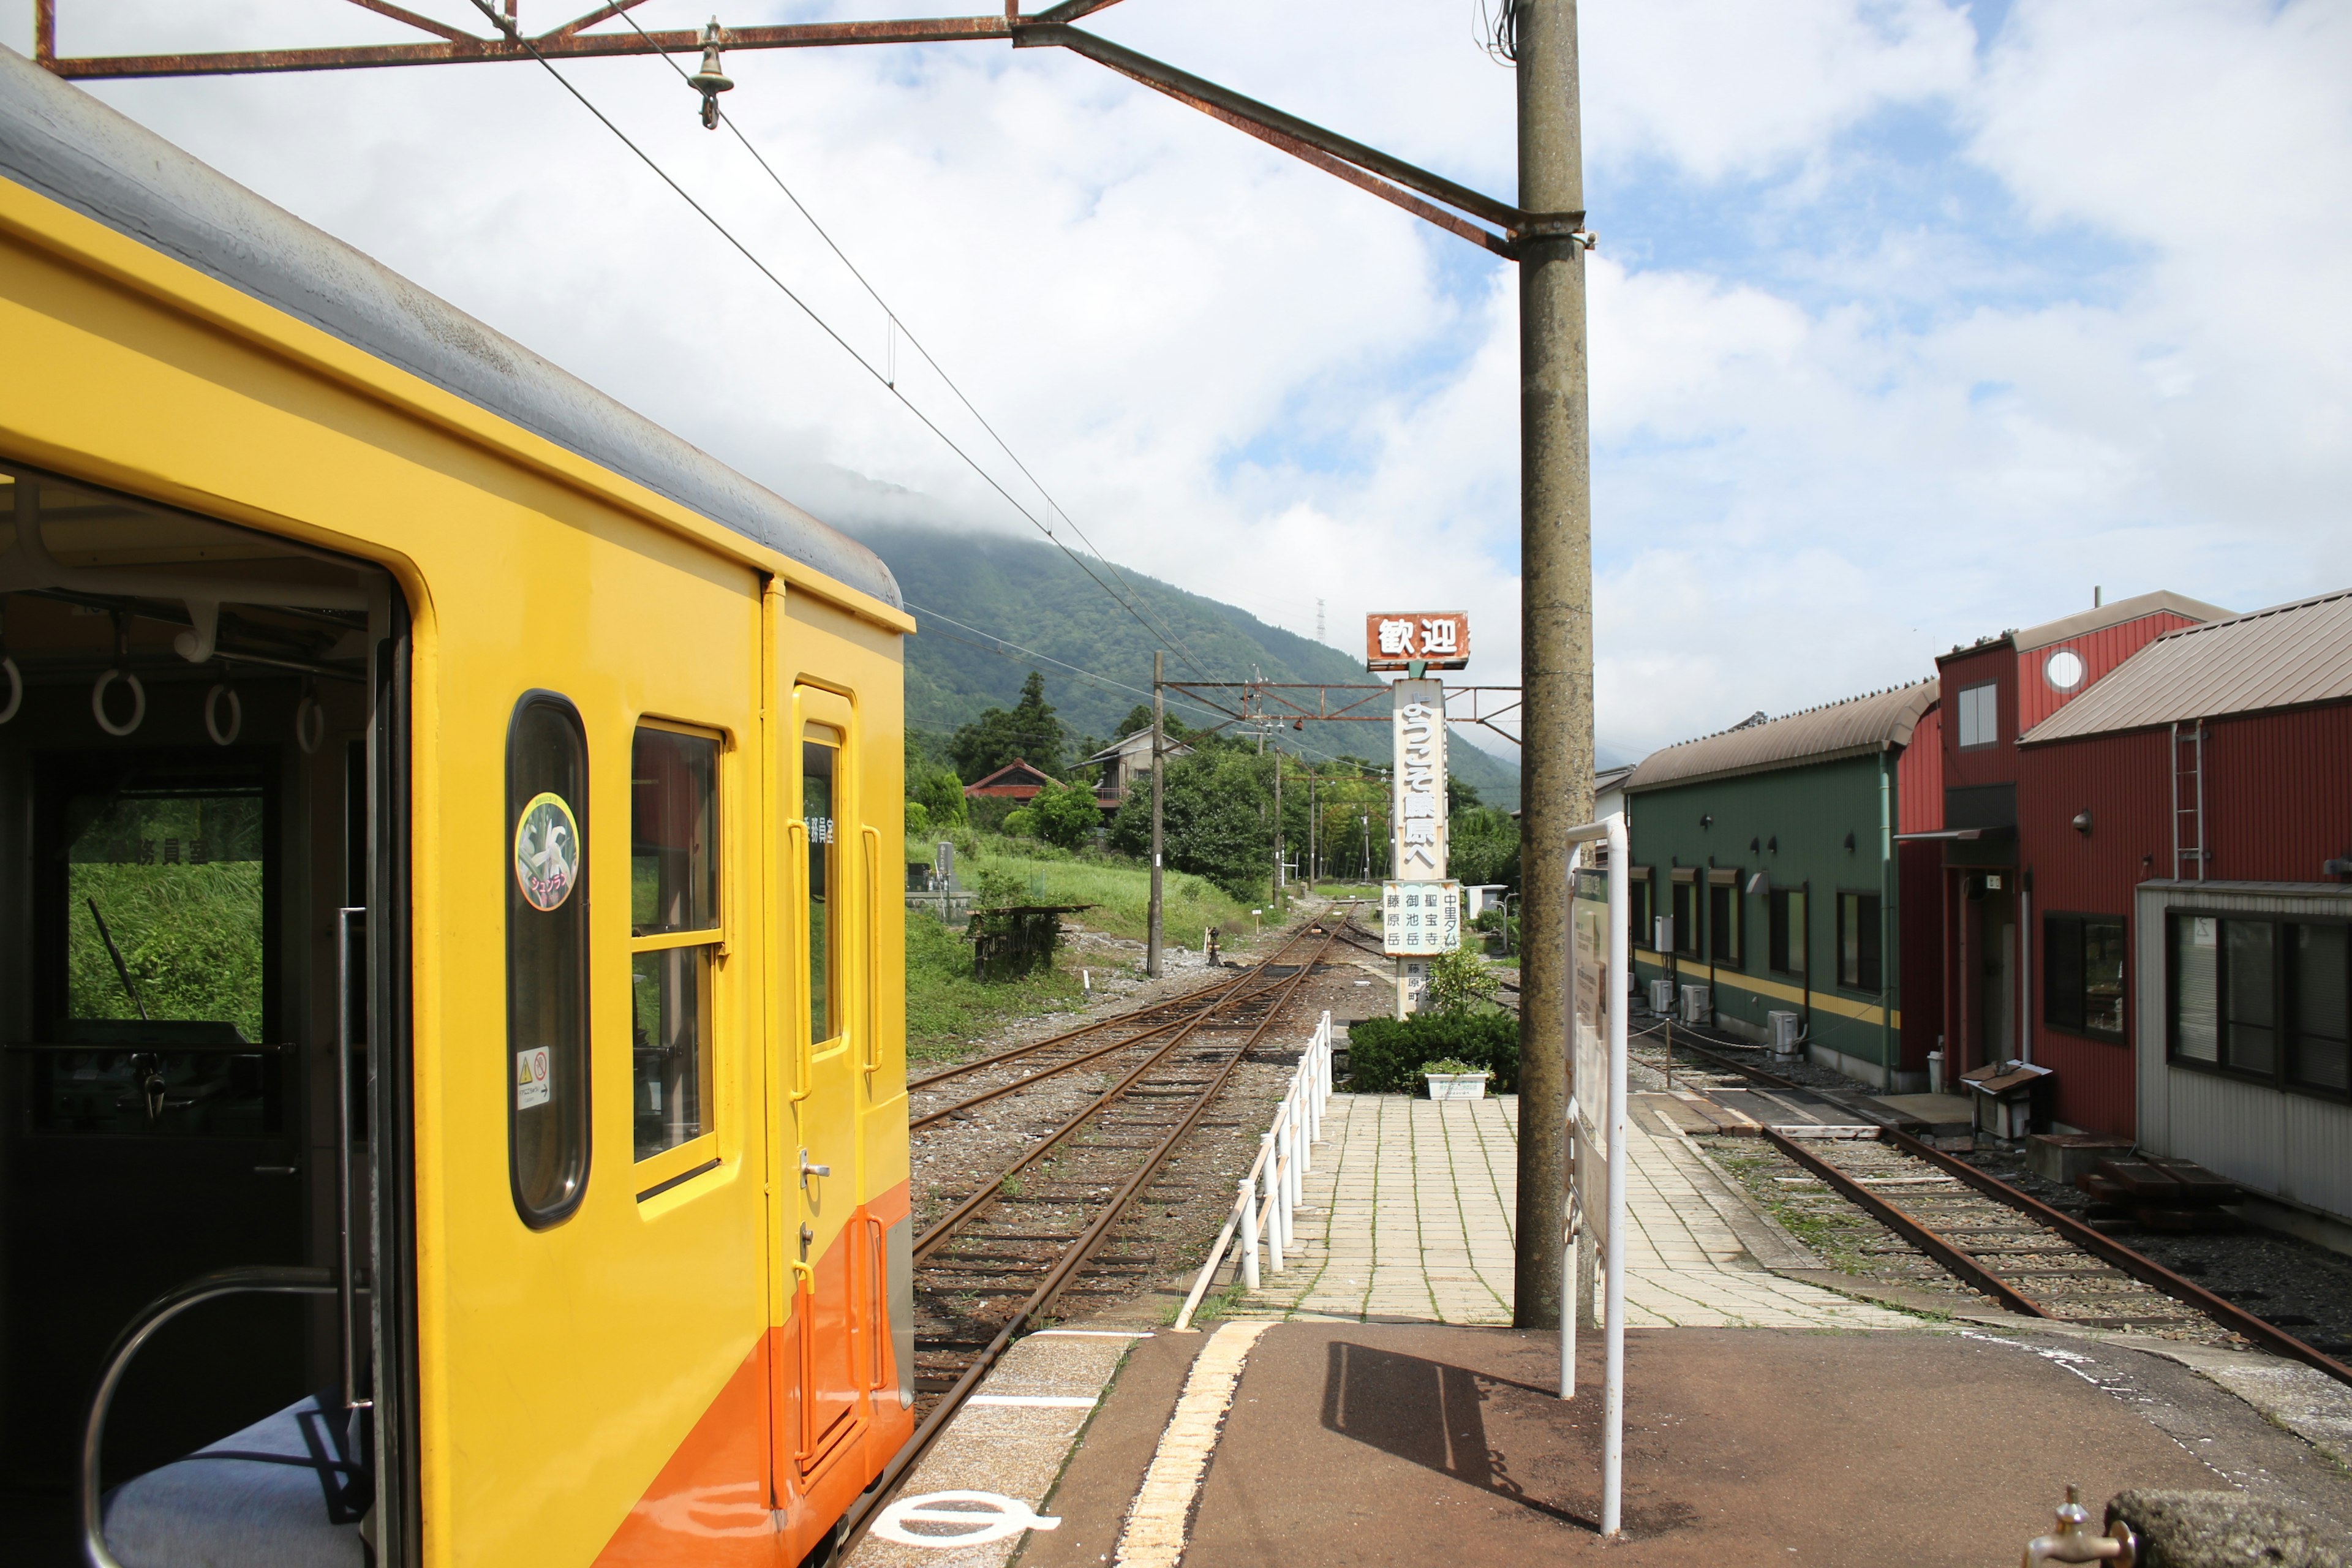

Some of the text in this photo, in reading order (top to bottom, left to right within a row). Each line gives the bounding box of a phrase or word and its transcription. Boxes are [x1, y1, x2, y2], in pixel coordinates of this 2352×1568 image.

[1379, 618, 1458, 654] 歓迎
[1402, 692, 1436, 869] ようこそ藤原へ
[532, 872, 567, 892] シュンラン
[1387, 894, 1400, 946] 藤原岳
[1406, 894, 1419, 946] 御池岳
[1425, 894, 1438, 946] 聖宝寺
[1444, 893, 1457, 947] 中里ダム
[1408, 963, 1420, 1001] 藤原町
